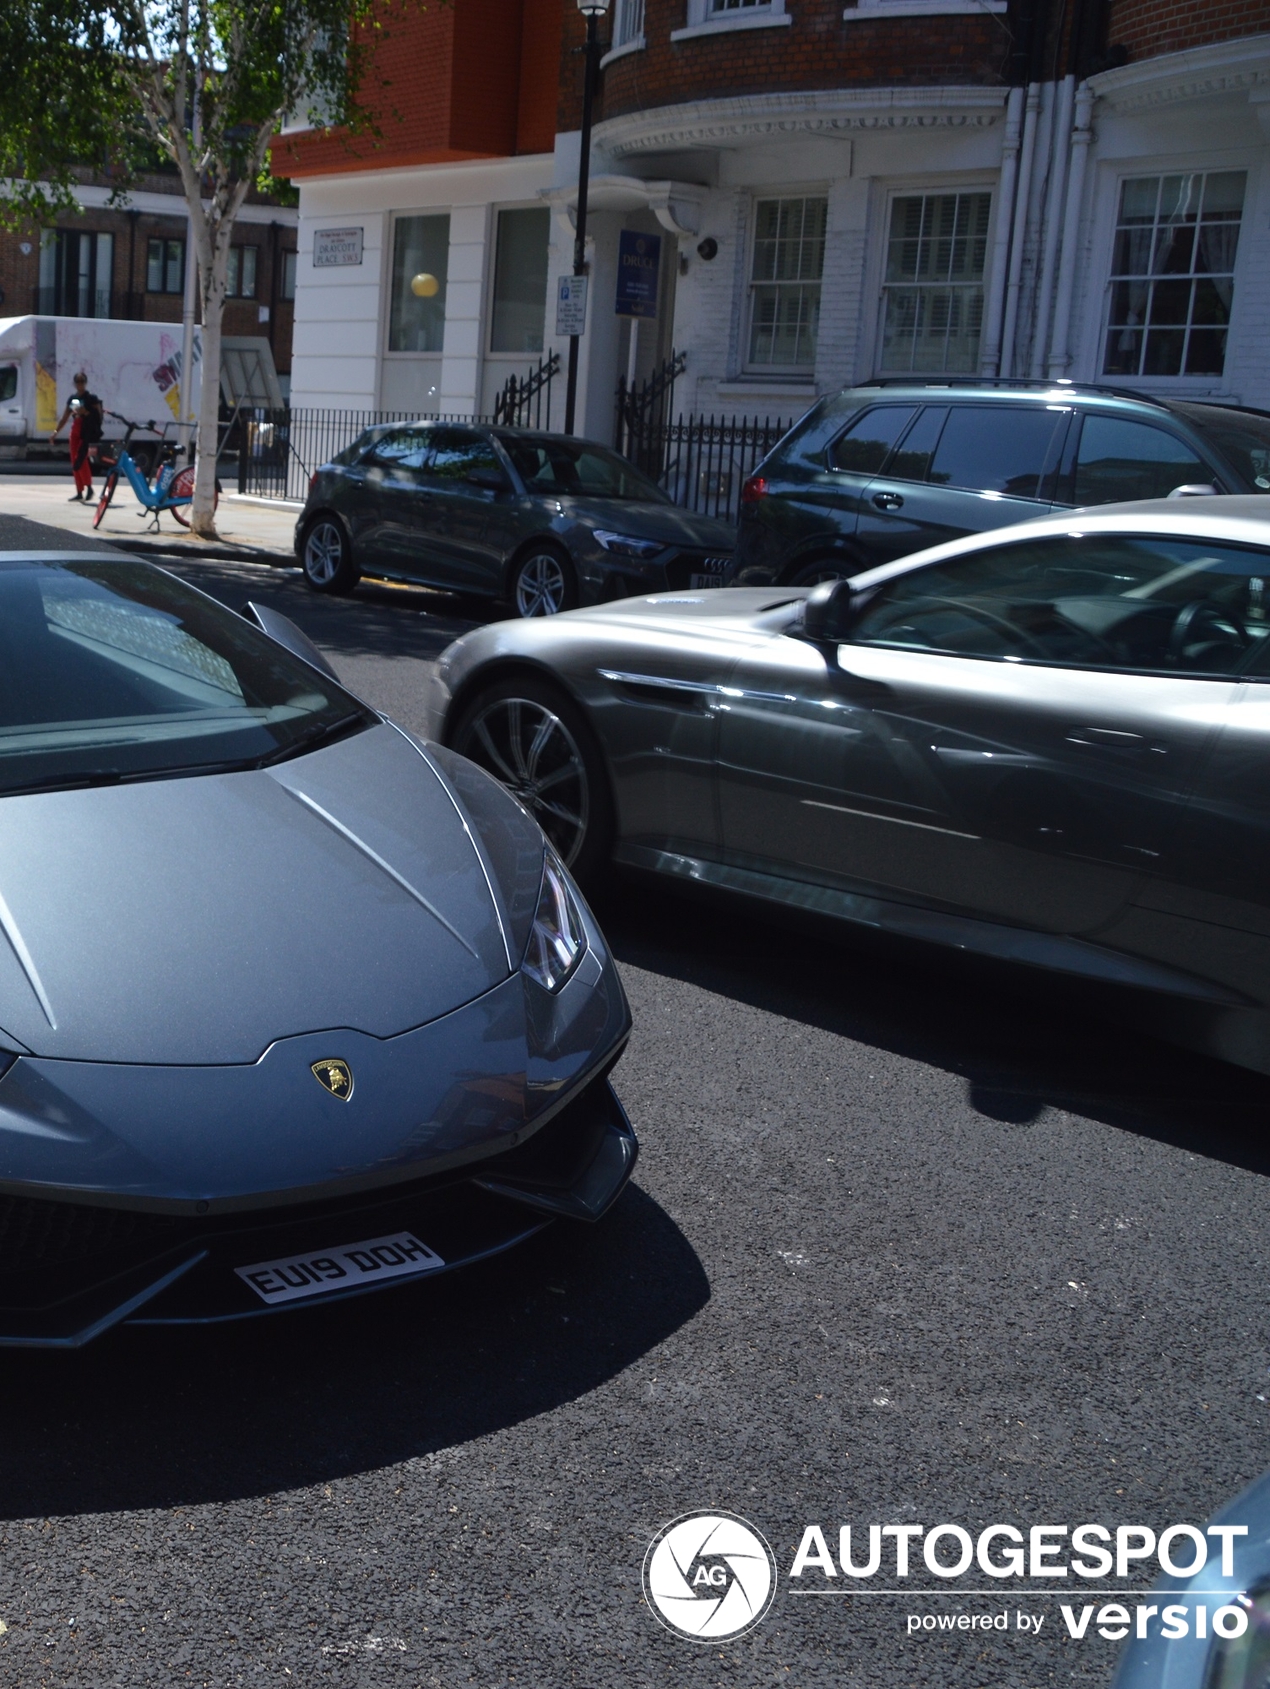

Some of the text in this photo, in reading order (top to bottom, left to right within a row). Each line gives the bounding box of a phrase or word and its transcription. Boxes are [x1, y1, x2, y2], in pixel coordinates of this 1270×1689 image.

[320, 243, 357, 254] DRAYCOTT
[317, 254, 338, 264] PLACE
[245, 1239, 433, 1295] EU19 DOH
